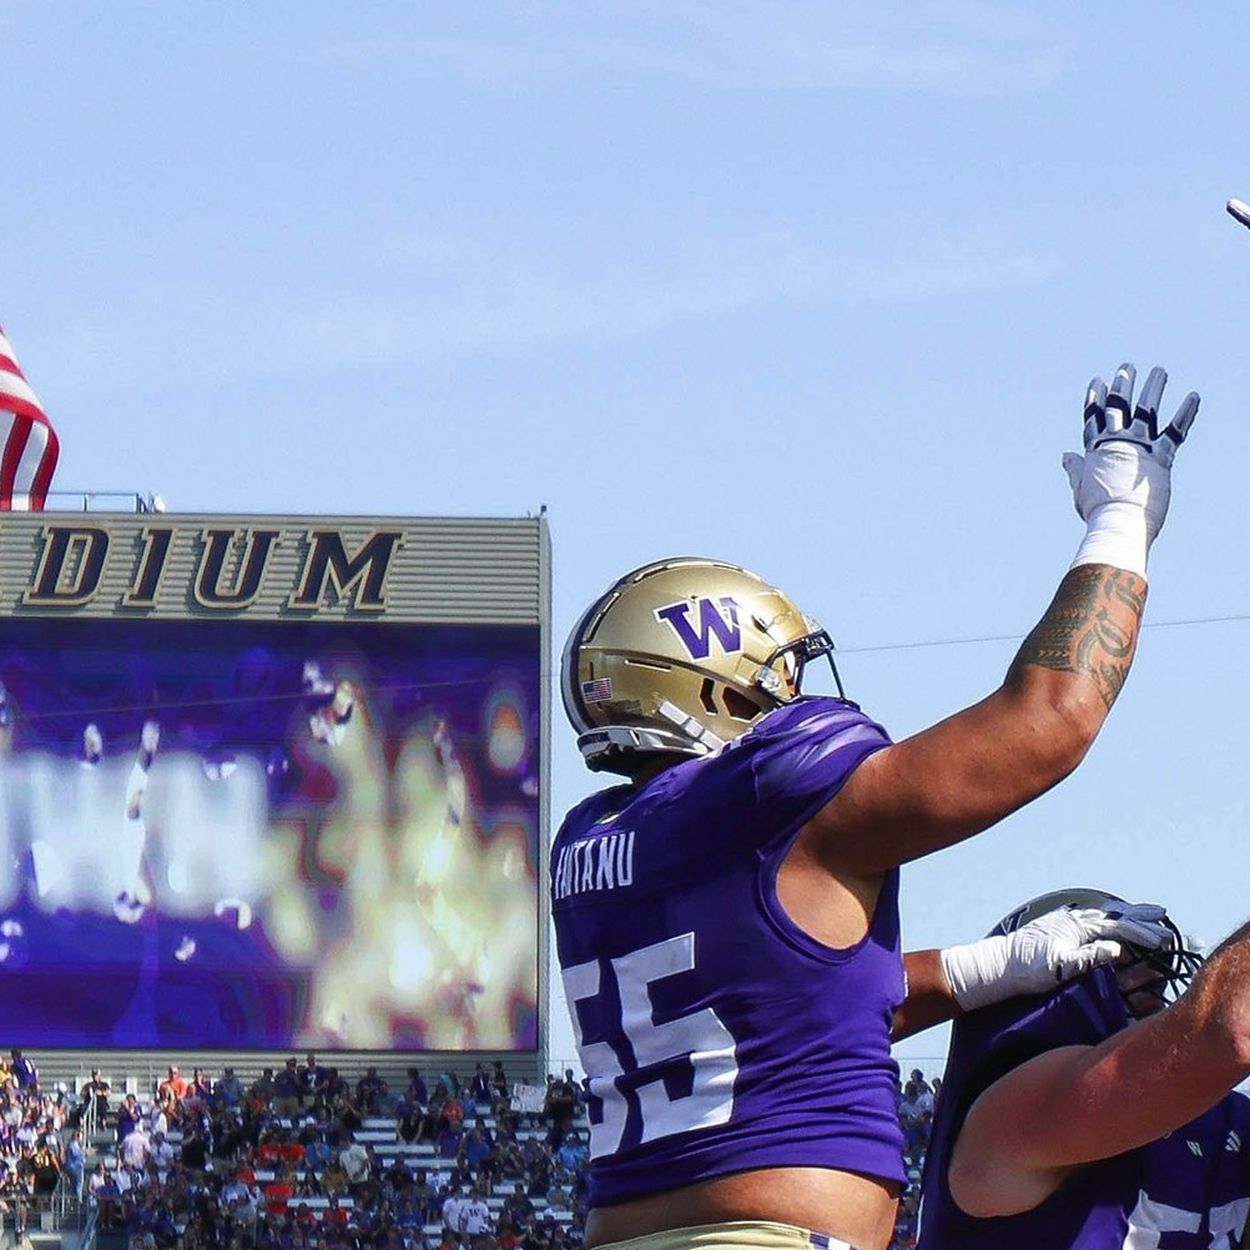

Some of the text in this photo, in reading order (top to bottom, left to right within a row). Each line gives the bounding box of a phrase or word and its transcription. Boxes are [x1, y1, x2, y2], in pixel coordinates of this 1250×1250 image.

[22, 523, 407, 612] DIUM
[653, 597, 744, 662] W
[561, 932, 740, 1162] 55
